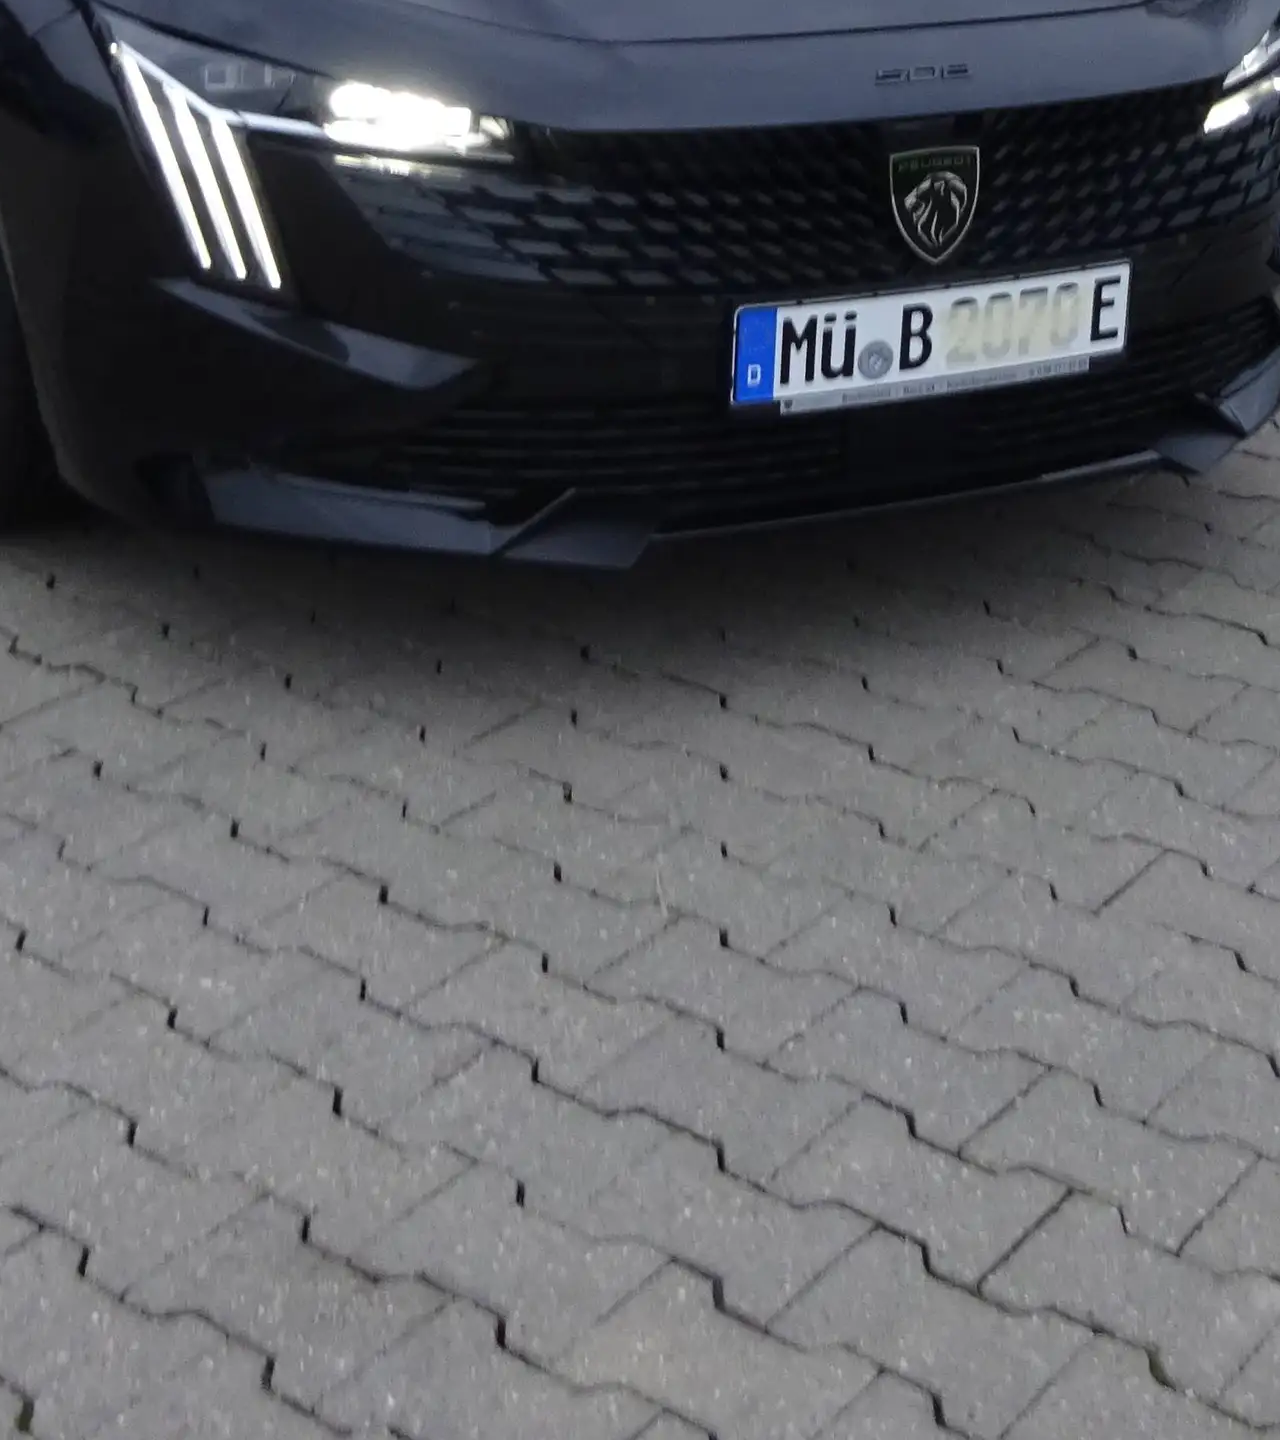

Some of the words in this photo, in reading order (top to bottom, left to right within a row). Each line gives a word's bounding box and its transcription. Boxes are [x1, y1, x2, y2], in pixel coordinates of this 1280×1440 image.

[780, 311, 858, 386] MÜ
[899, 302, 933, 370] B
[747, 363, 761, 387] D
